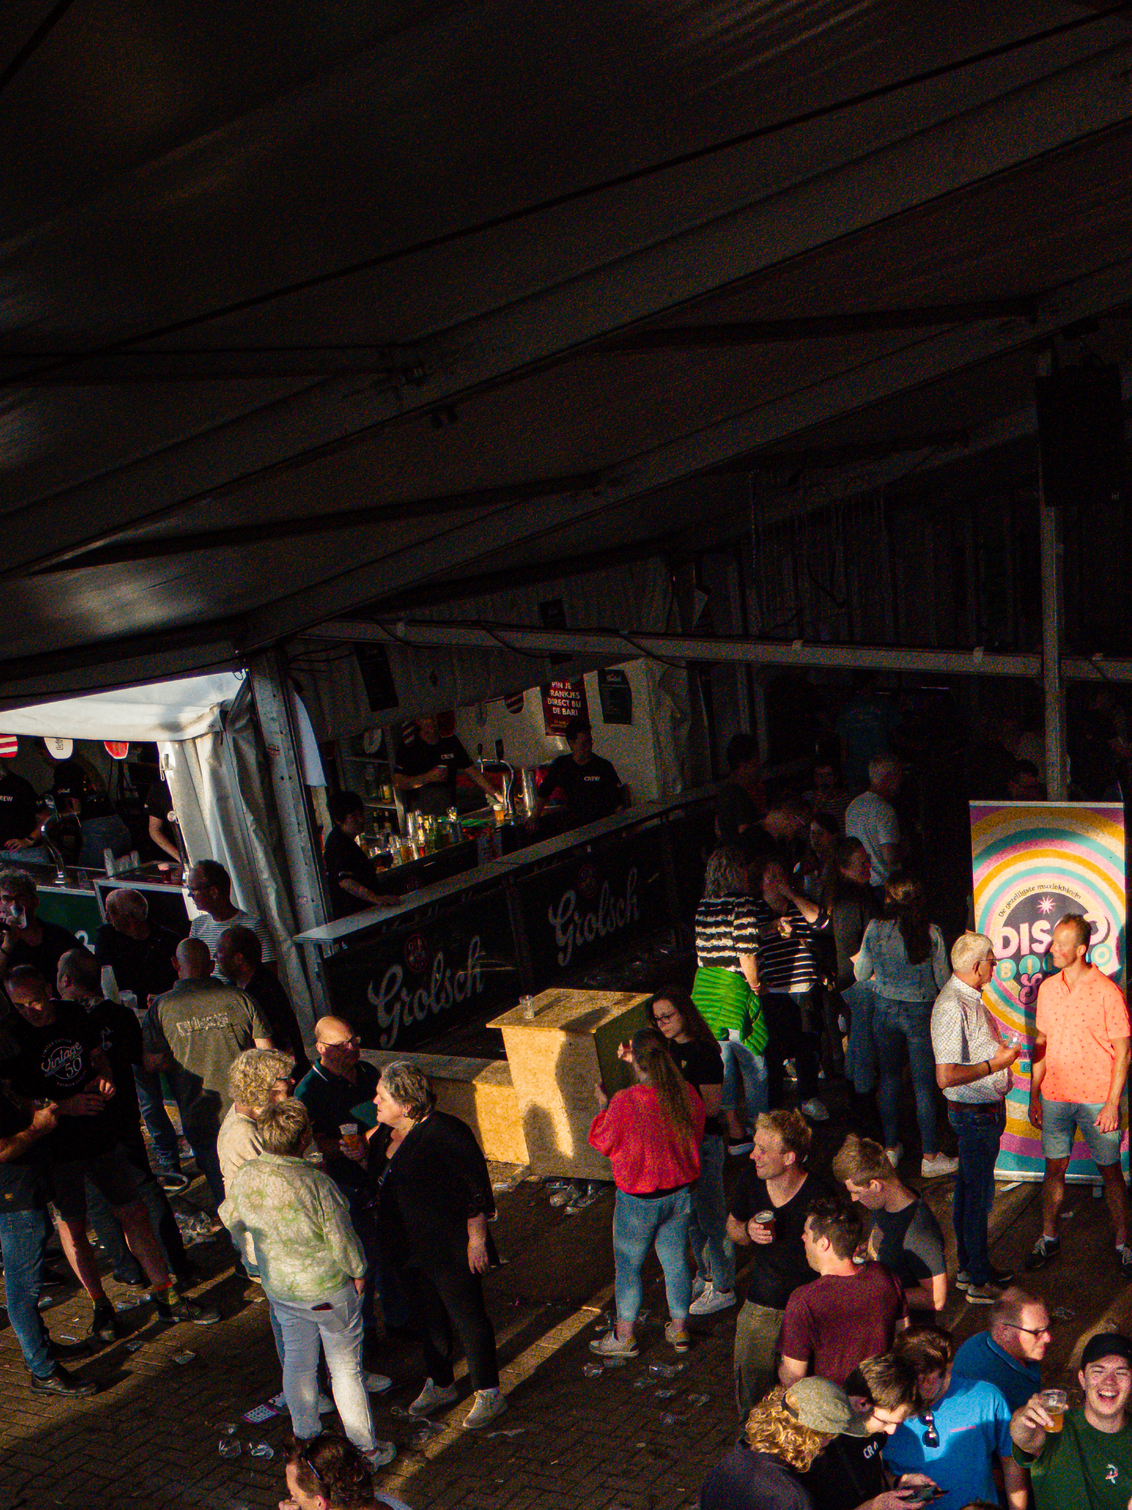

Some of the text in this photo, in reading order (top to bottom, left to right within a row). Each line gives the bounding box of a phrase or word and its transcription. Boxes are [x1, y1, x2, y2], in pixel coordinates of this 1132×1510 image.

[547, 698, 570, 707] DIRECT
[549, 689, 580, 699] RANKJES
[552, 707, 561, 715] DE
[548, 867, 640, 966] Grolsch
[993, 912, 1111, 959] DISO
[999, 946, 1111, 979] BIO
[367, 935, 485, 1049] Grolsch
[40, 1041, 83, 1073] Vintage
[65, 1058, 83, 1078] 50
